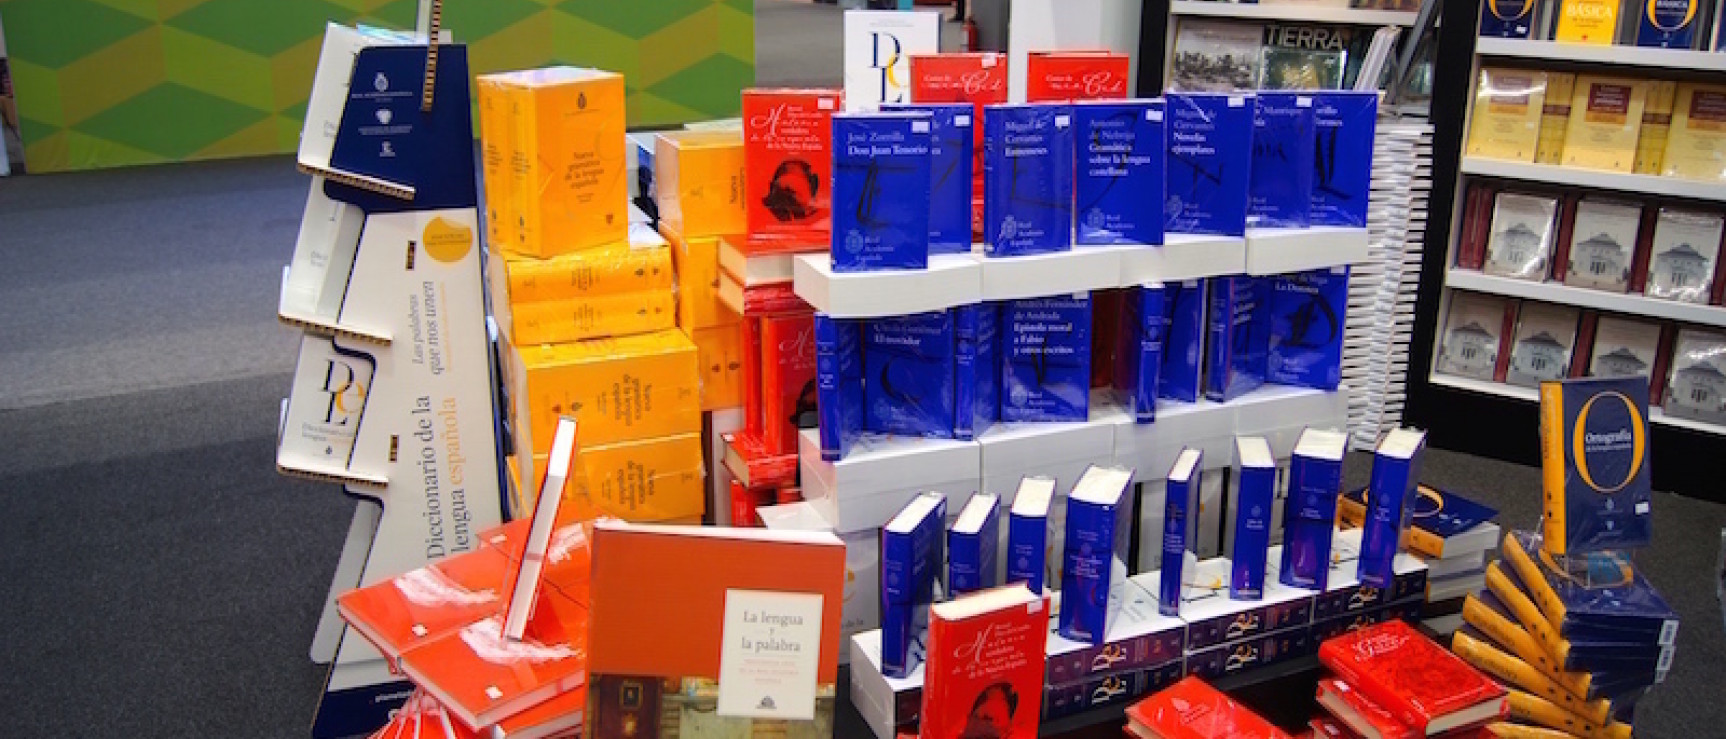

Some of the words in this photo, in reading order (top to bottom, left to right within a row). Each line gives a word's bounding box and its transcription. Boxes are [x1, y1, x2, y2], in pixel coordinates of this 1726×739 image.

[1265, 24, 1343, 50] TIERRA
[847, 131, 866, 142] José
[869, 131, 905, 142] Zorrilla
[1005, 135, 1043, 144] Cervantes
[1173, 132, 1206, 142] Novelas
[574, 151, 594, 159] Nueva
[847, 145, 870, 155] Don
[870, 145, 892, 158] Juan
[893, 145, 928, 155] Tenorio
[1089, 143, 1134, 153] Gramática
[1171, 144, 1216, 156] ejemplares
[1089, 155, 1112, 164] sobre
[1112, 155, 1120, 164] la
[1121, 155, 1151, 166] lengua
[1089, 166, 1129, 176] castellana
[422, 281, 437, 317] unen
[408, 294, 425, 343] palabras
[425, 320, 438, 347] nos
[1014, 322, 1047, 334] Epístola
[1048, 321, 1073, 332] moral
[1020, 333, 1045, 344] Fabio
[411, 343, 423, 365] Las
[429, 348, 445, 375] que
[411, 396, 431, 414] la
[414, 418, 434, 441] de
[1585, 428, 1632, 446] Ortografía
[437, 397, 467, 485] española
[1573, 391, 1646, 493] O
[416, 447, 446, 559] Diccionario
[450, 488, 471, 553] lengua
[743, 610, 757, 623] La
[761, 610, 804, 627] lengua
[741, 636, 752, 649] la
[755, 637, 801, 653] palabra
